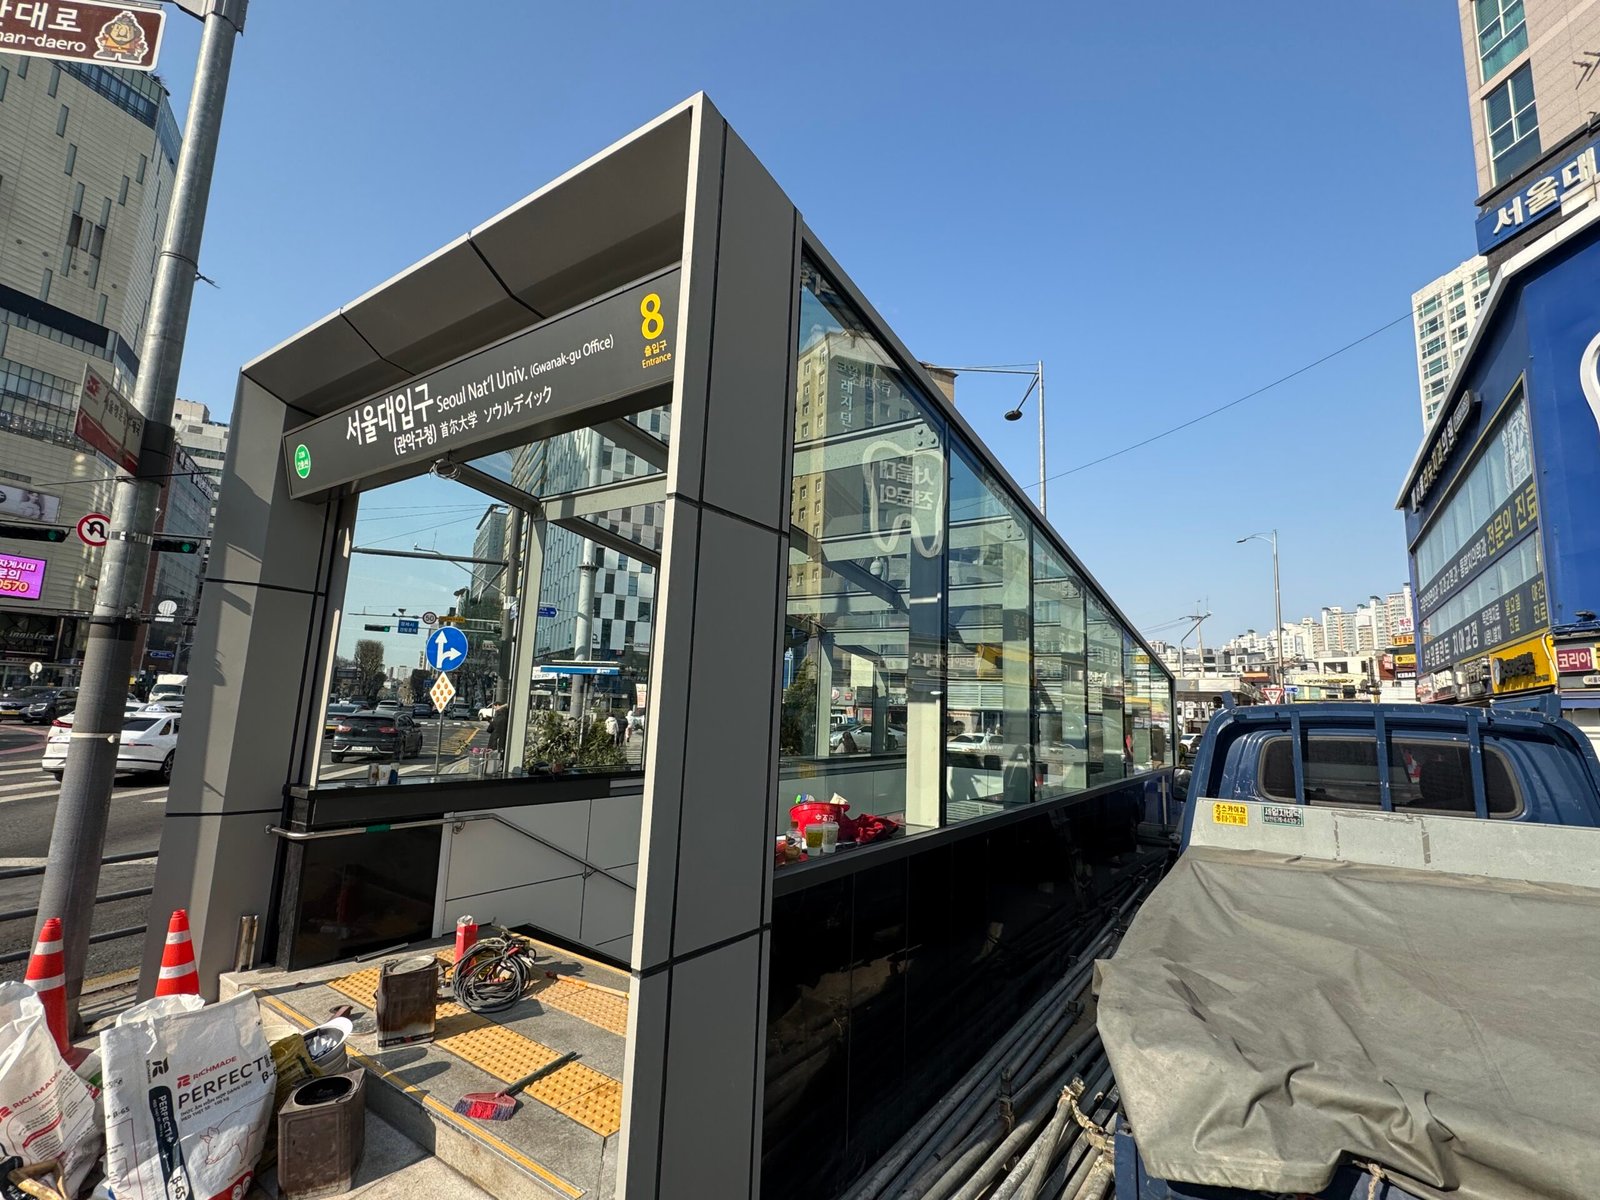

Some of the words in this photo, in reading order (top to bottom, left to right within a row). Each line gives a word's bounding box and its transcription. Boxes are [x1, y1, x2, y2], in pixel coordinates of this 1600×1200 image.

[1493, 146, 1598, 235] 서울대
[640, 293, 665, 340] 8
[641, 351, 672, 369] Entrance
[644, 340, 668, 358] 출입구
[436, 386, 467, 414] Seoul
[496, 366, 528, 393] Univ.
[529, 346, 582, 379] (Gwanak-gu
[582, 333, 615, 359] Office)
[346, 382, 434, 446] 서울대입구
[840, 379, 854, 434] 레지던
[393, 423, 438, 456] (관악구청)
[440, 411, 478, 439] 首尔大学
[1486, 498, 1514, 558] 전문의
[1515, 482, 1538, 532] 진료
[1531, 581, 1545, 601] 야간
[1508, 615, 1521, 634] 진료
[1533, 602, 1547, 624] 진료
[9, 630, 55, 641] innisfree
[1452, 619, 1479, 663] 치아교정
[1558, 651, 1591, 668] 코리아
[178, 1056, 264, 1110] PERFECT
[192, 1056, 237, 1080] RICHMADE
